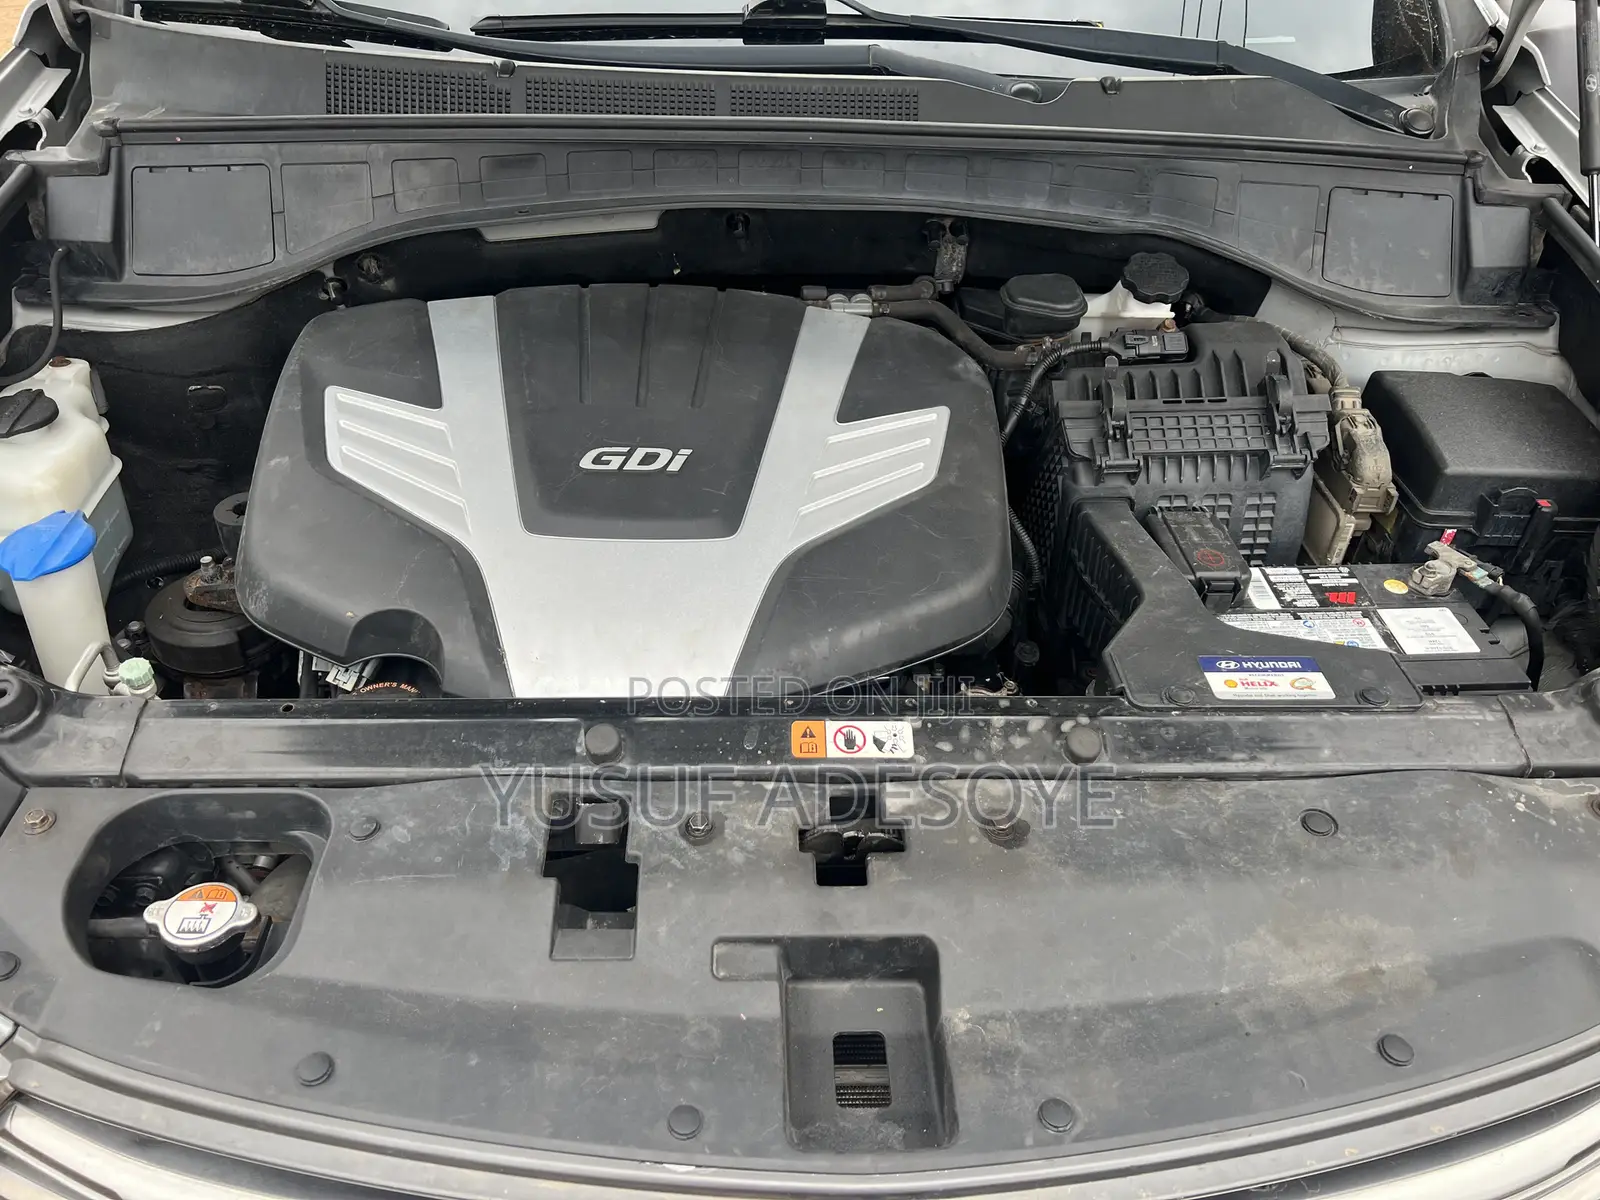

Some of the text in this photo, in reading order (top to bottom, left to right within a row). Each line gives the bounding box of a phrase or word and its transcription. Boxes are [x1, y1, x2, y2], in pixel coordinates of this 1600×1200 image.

[579, 446, 693, 472] GDi
[1242, 661, 1302, 669] HYUNDAI
[360, 682, 397, 693] OWNER'S
